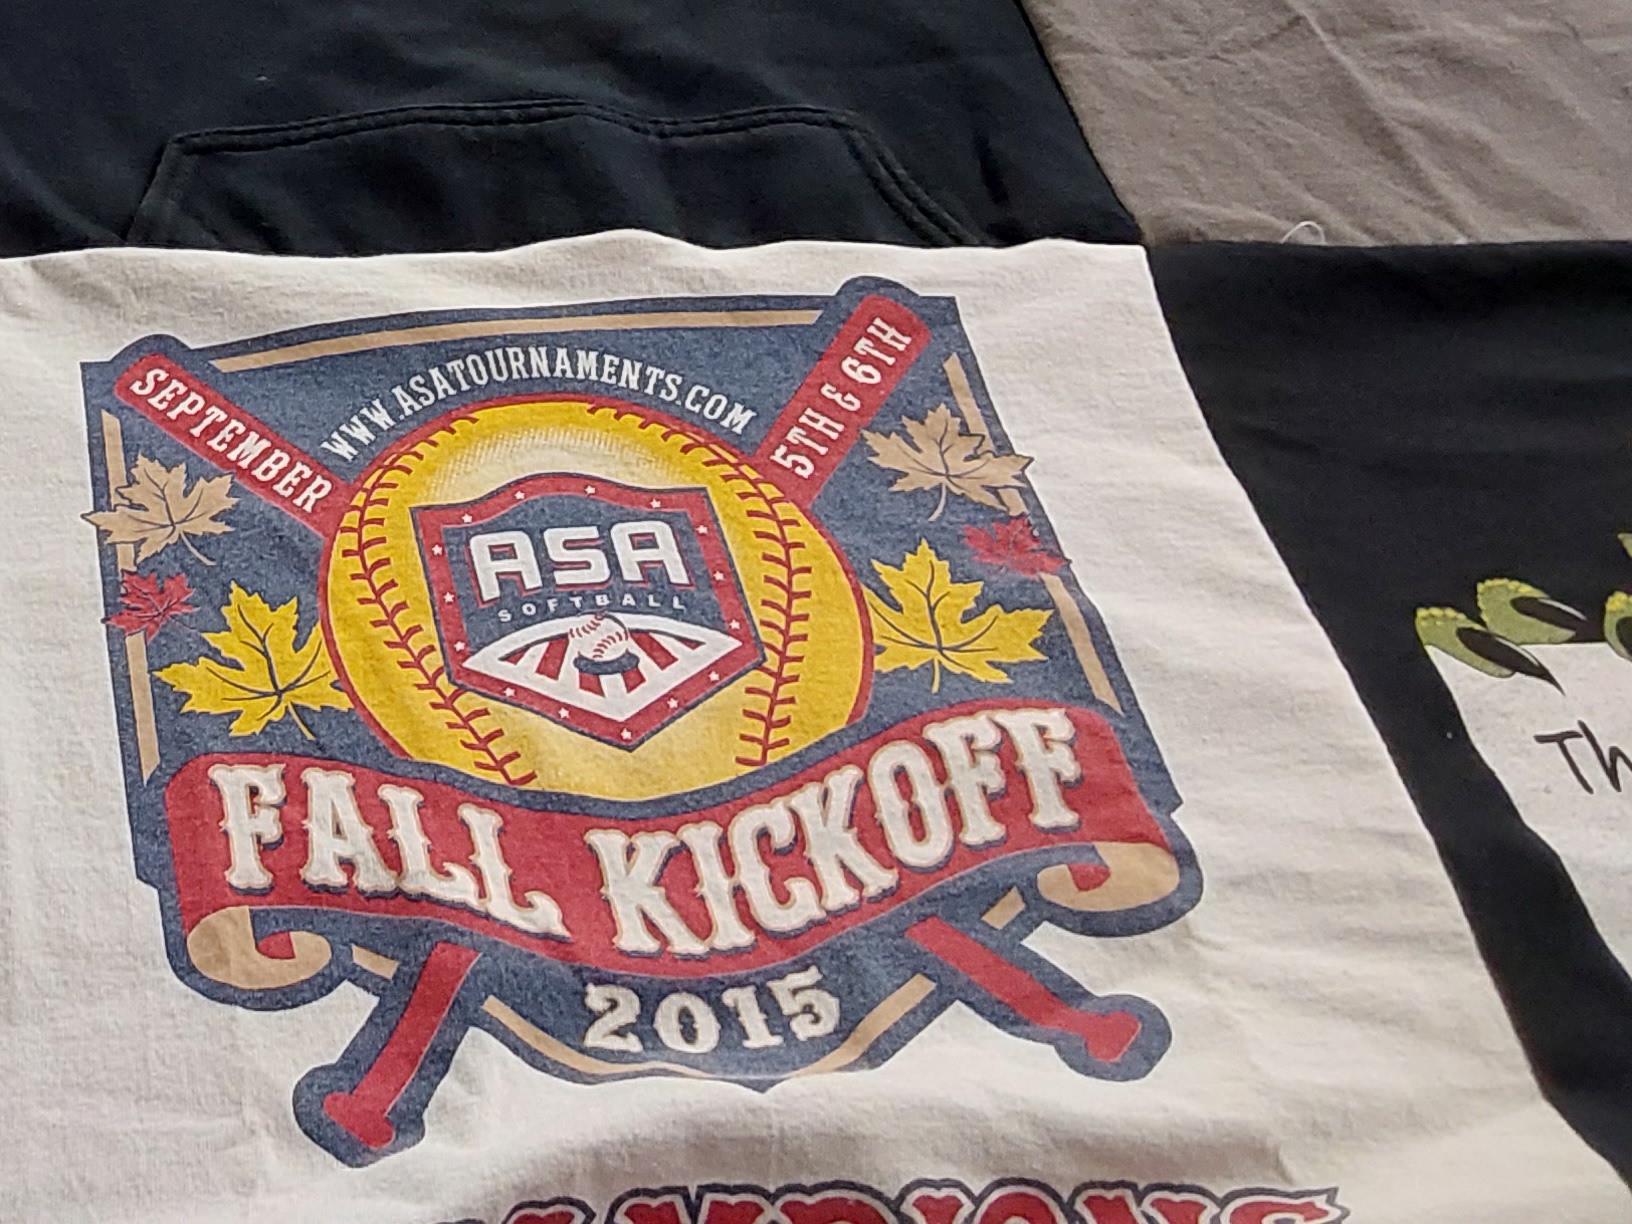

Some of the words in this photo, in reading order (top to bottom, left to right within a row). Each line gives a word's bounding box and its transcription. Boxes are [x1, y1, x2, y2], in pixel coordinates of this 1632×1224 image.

[129, 367, 338, 514] SEPTEMBER
[322, 347, 758, 463] WWW.ASATOURNAMENTS.COM
[770, 407, 845, 479] 5TH
[841, 317, 912, 384] 6TH
[466, 520, 694, 604] ASA
[498, 592, 688, 623] SOFTBALL
[207, 762, 574, 939] FALL
[582, 706, 1086, 960] KICKOFF
[581, 964, 842, 1054] 2015
